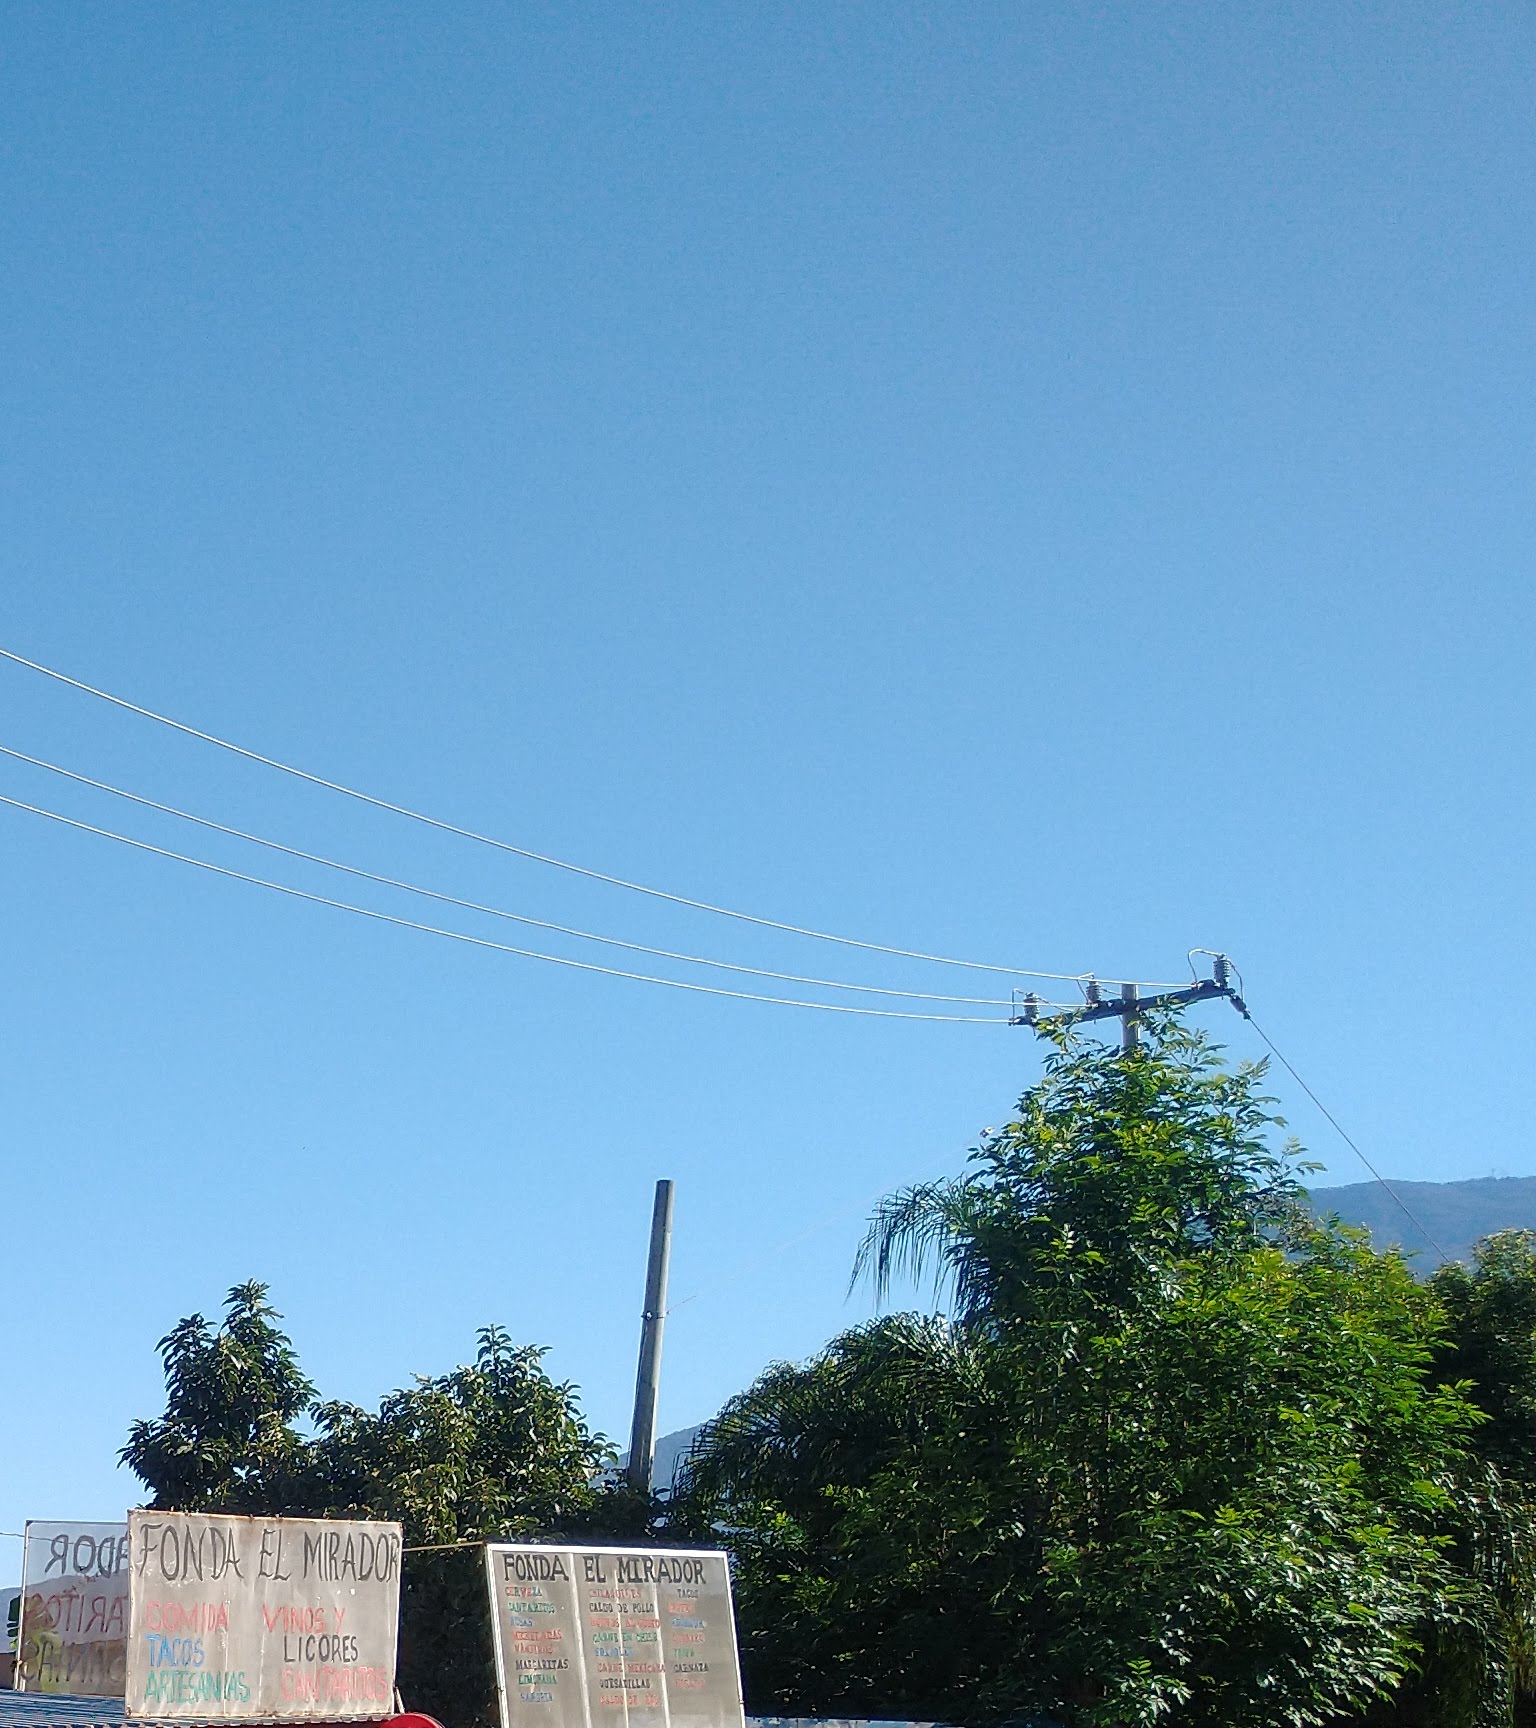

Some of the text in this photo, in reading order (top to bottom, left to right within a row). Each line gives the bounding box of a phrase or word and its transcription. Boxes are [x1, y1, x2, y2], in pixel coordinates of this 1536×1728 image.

[139, 1522, 401, 1583] FONDA EL MIRADOR
[502, 1553, 707, 1584] FONDA EL MIRADOR
[145, 1599, 229, 1633] COMIDA
[262, 1603, 346, 1634] VINOS Y
[618, 1603, 628, 1614] DE
[632, 1602, 654, 1613] POLLO
[144, 1633, 206, 1668] TACOS
[284, 1634, 359, 1663] LICORES
[515, 1658, 569, 1670] MARGARITAS
[144, 1670, 251, 1704] ARTESANIAS
[281, 1667, 388, 1701] CANTARITOS
